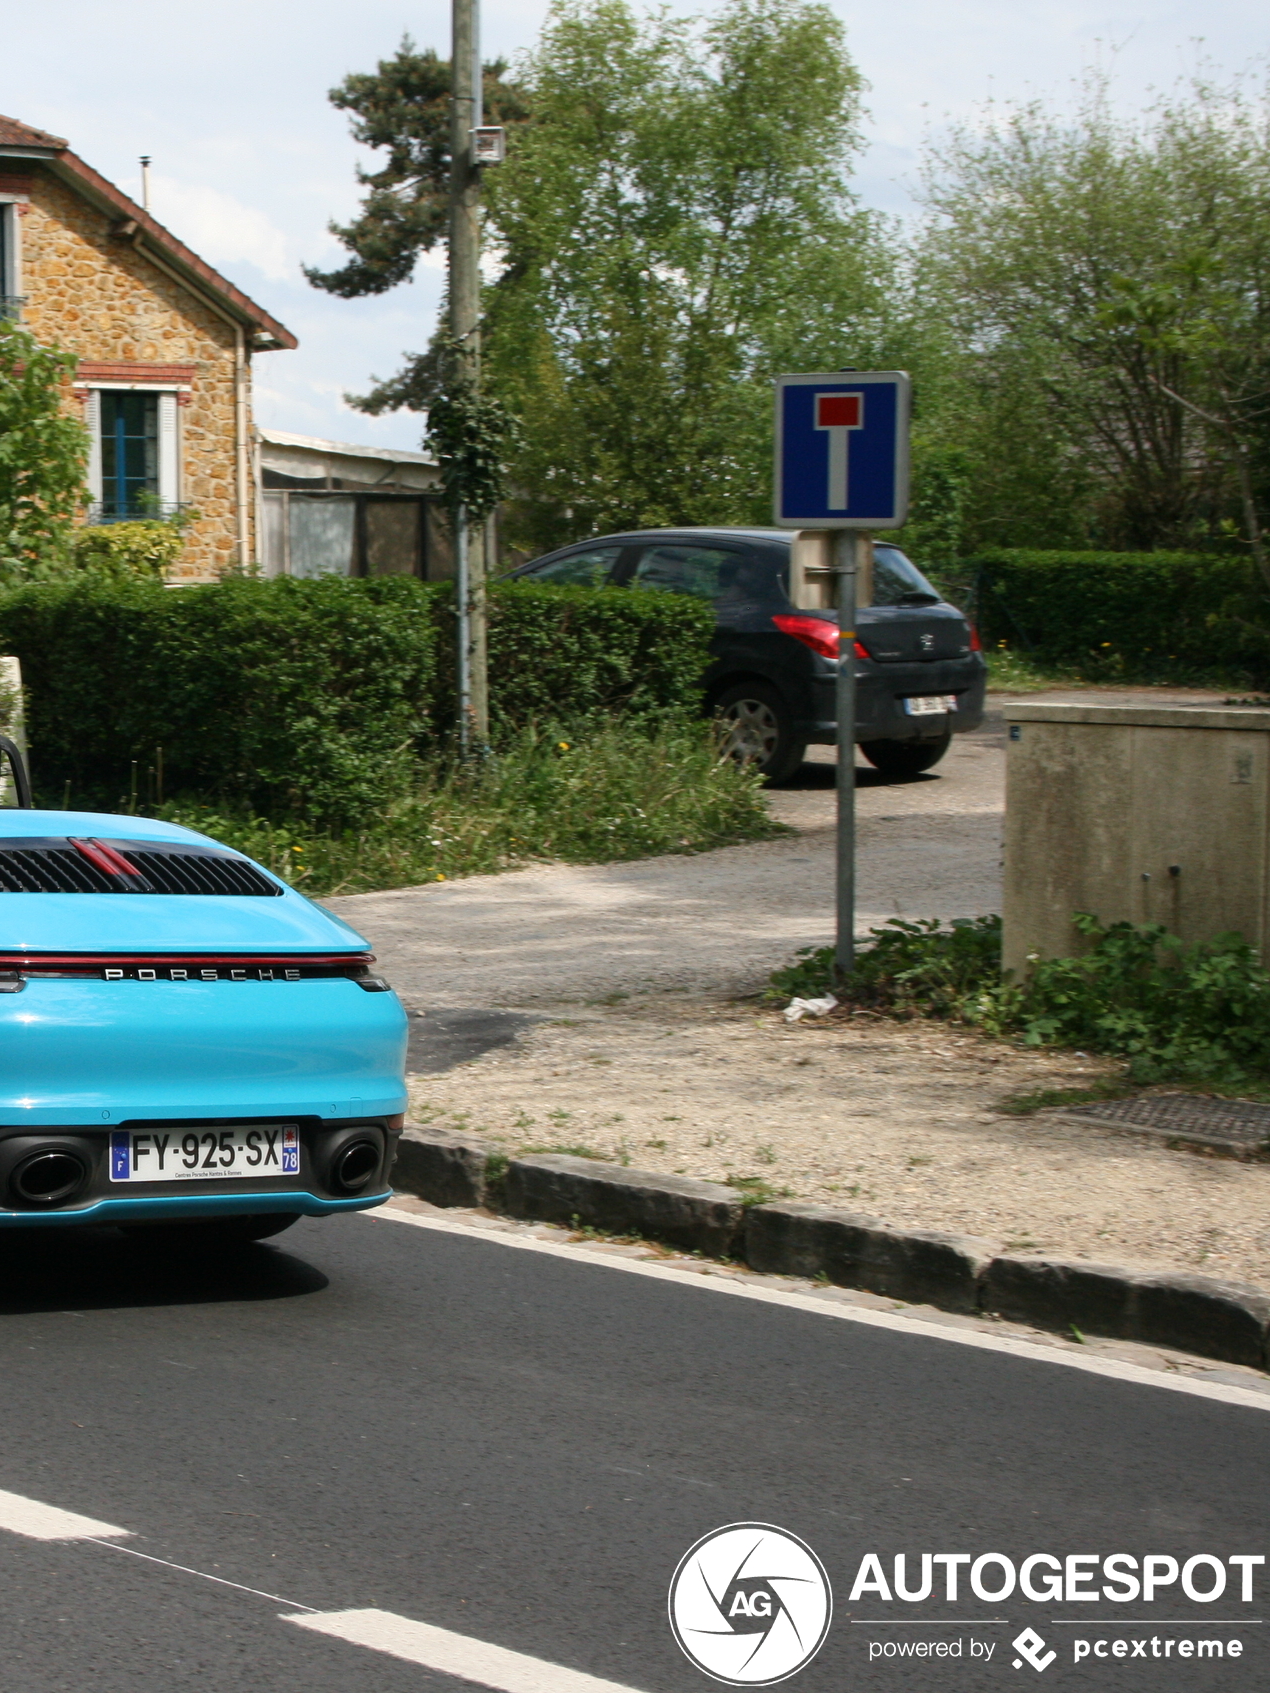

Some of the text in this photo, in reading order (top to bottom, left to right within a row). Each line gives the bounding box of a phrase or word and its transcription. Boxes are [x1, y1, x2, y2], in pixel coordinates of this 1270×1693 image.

[104, 968, 301, 981] PORSCHE
[132, 1129, 279, 1172] FY-925-SX
[117, 1161, 124, 1171] F
[283, 1152, 297, 1169] 78
